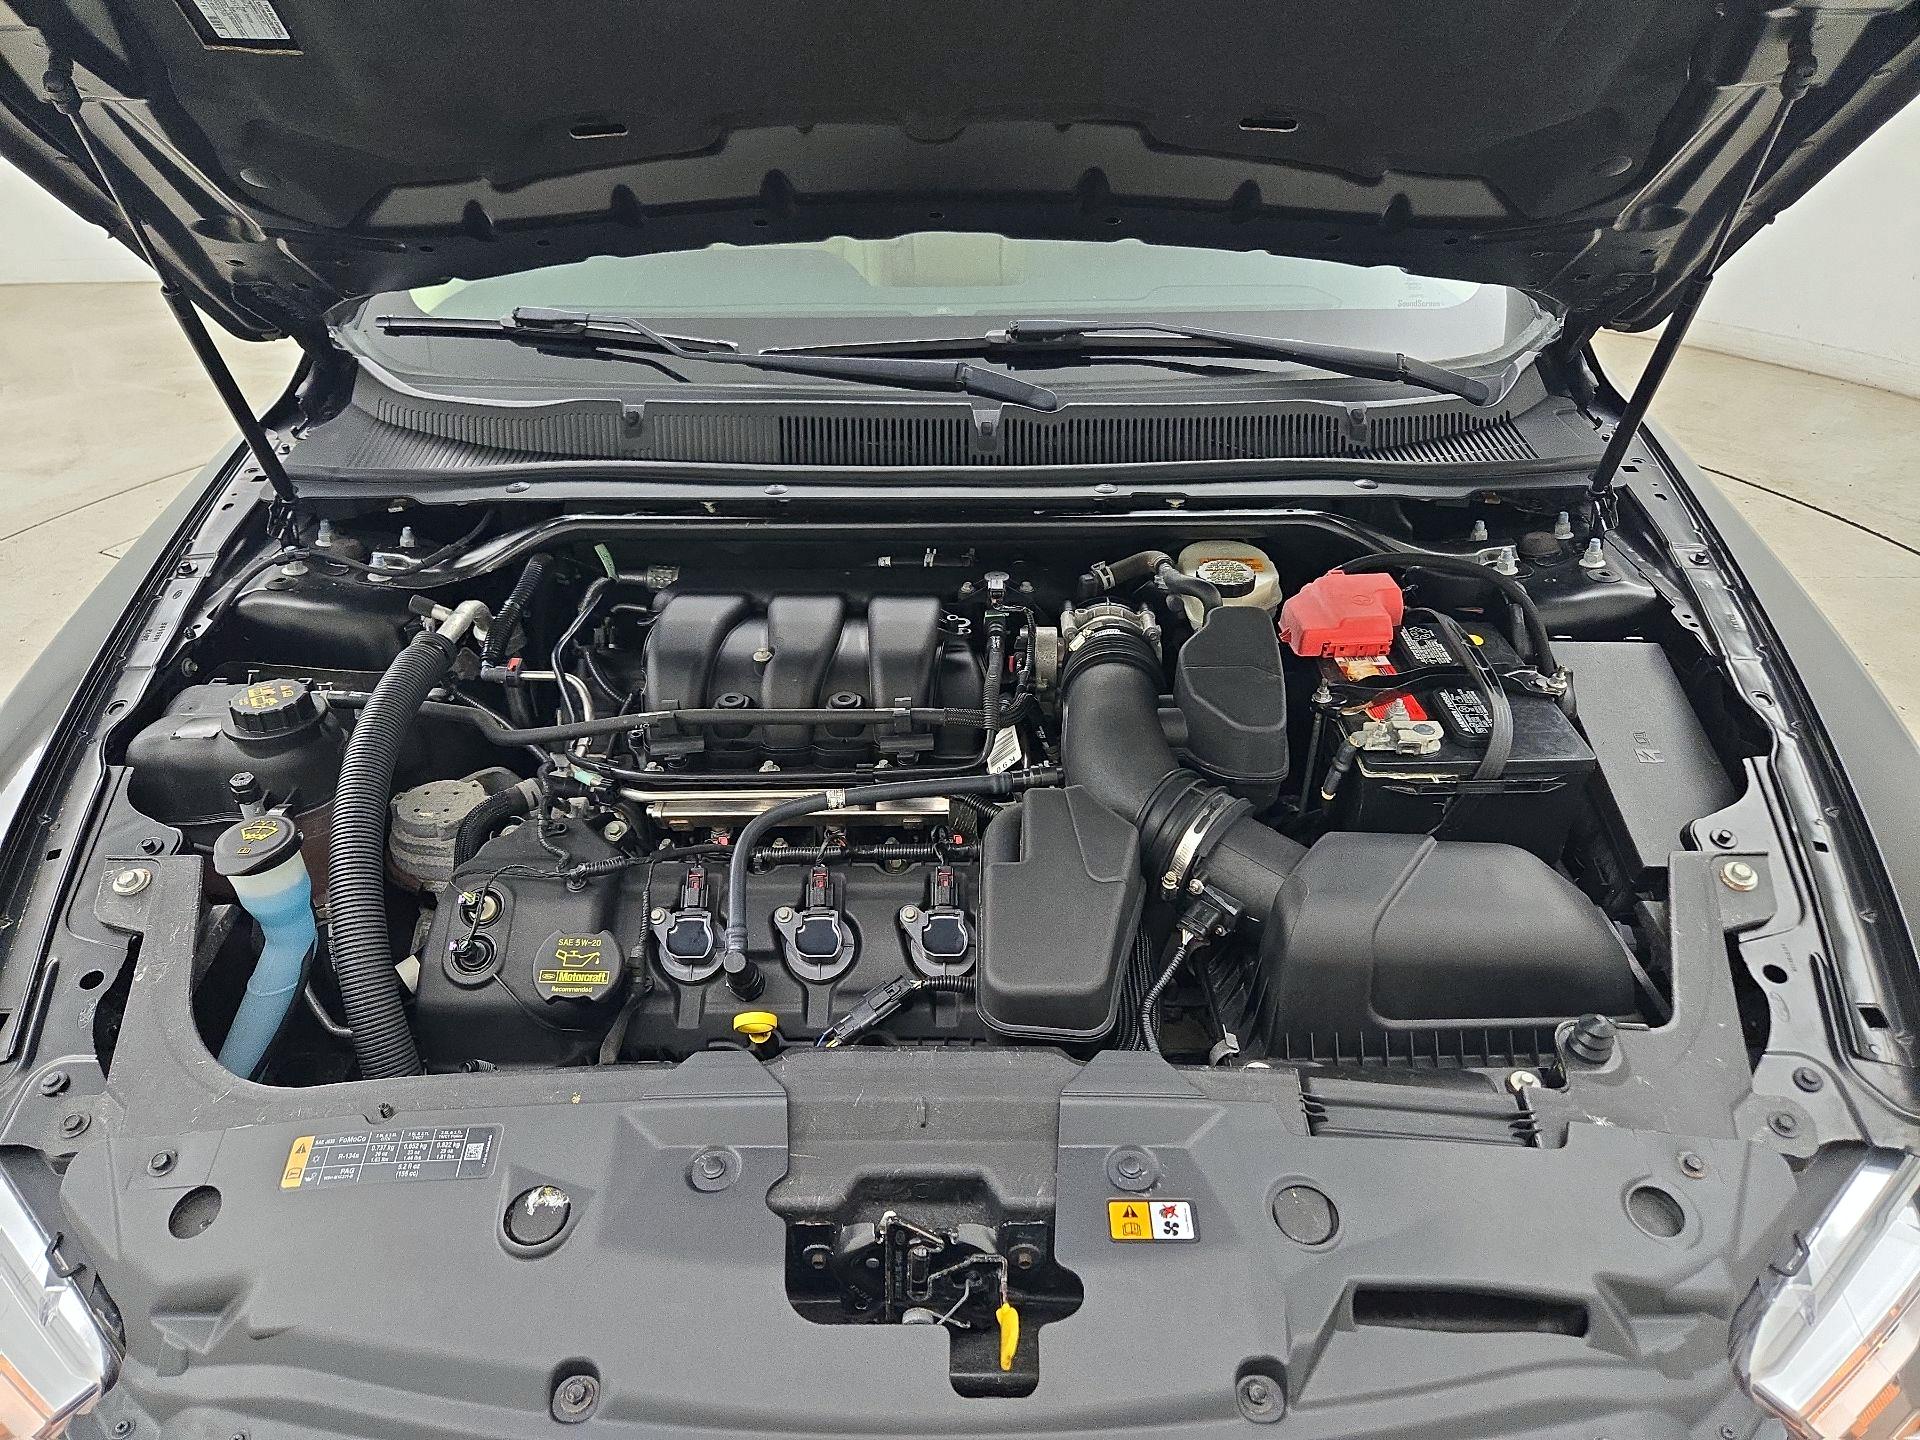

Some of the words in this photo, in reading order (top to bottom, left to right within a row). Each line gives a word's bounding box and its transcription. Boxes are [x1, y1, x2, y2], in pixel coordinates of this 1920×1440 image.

[558, 938, 574, 946] SAE
[575, 938, 602, 947] 5W-20
[558, 971, 607, 983] Motorcraft
[551, 985, 593, 993] Recommended
[338, 1135, 367, 1144] FoMoCo
[387, 1144, 396, 1152] kg
[419, 1142, 428, 1150] kg
[452, 1141, 461, 1149] kg
[338, 1152, 360, 1160] R-134a
